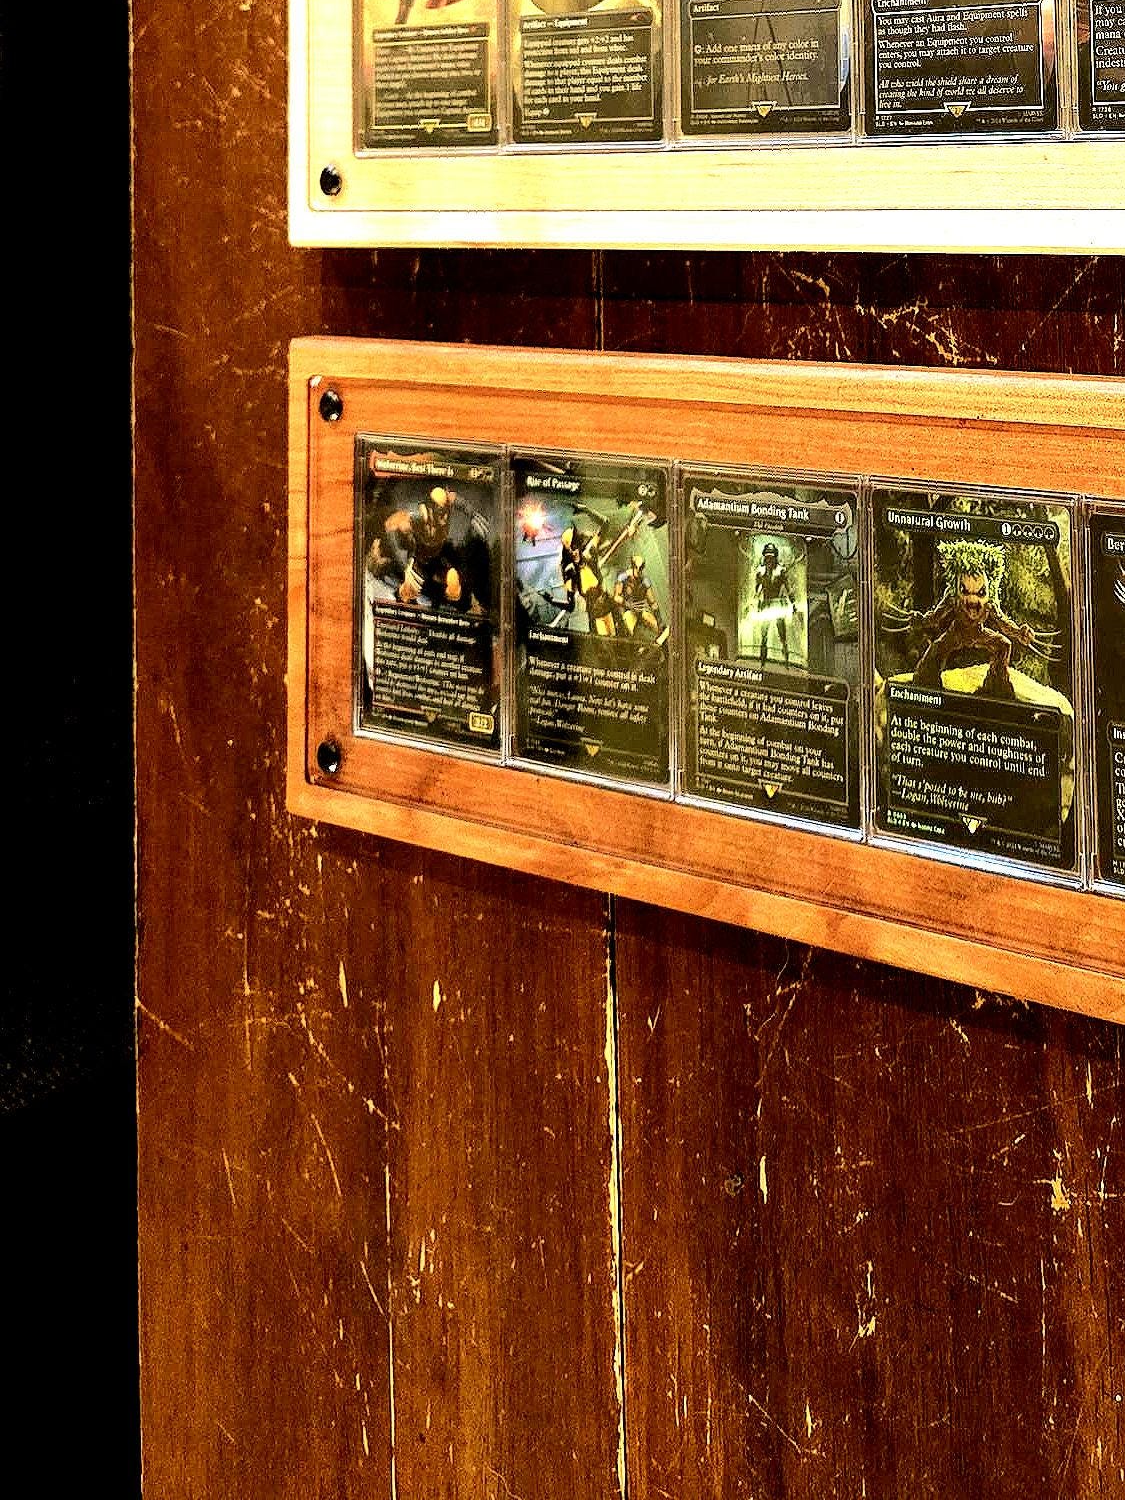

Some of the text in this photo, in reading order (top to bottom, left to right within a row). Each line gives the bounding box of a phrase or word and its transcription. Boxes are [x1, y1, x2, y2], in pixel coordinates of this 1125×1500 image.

[1104, 6, 1122, 17] you
[1094, 19, 1116, 29] may
[1095, 31, 1122, 39] mana
[887, 511, 971, 532] Unnatural Growth
[890, 687, 941, 705] Enchantment
[903, 718, 918, 729] the
[919, 720, 963, 740] beginning
[976, 732, 998, 743] each
